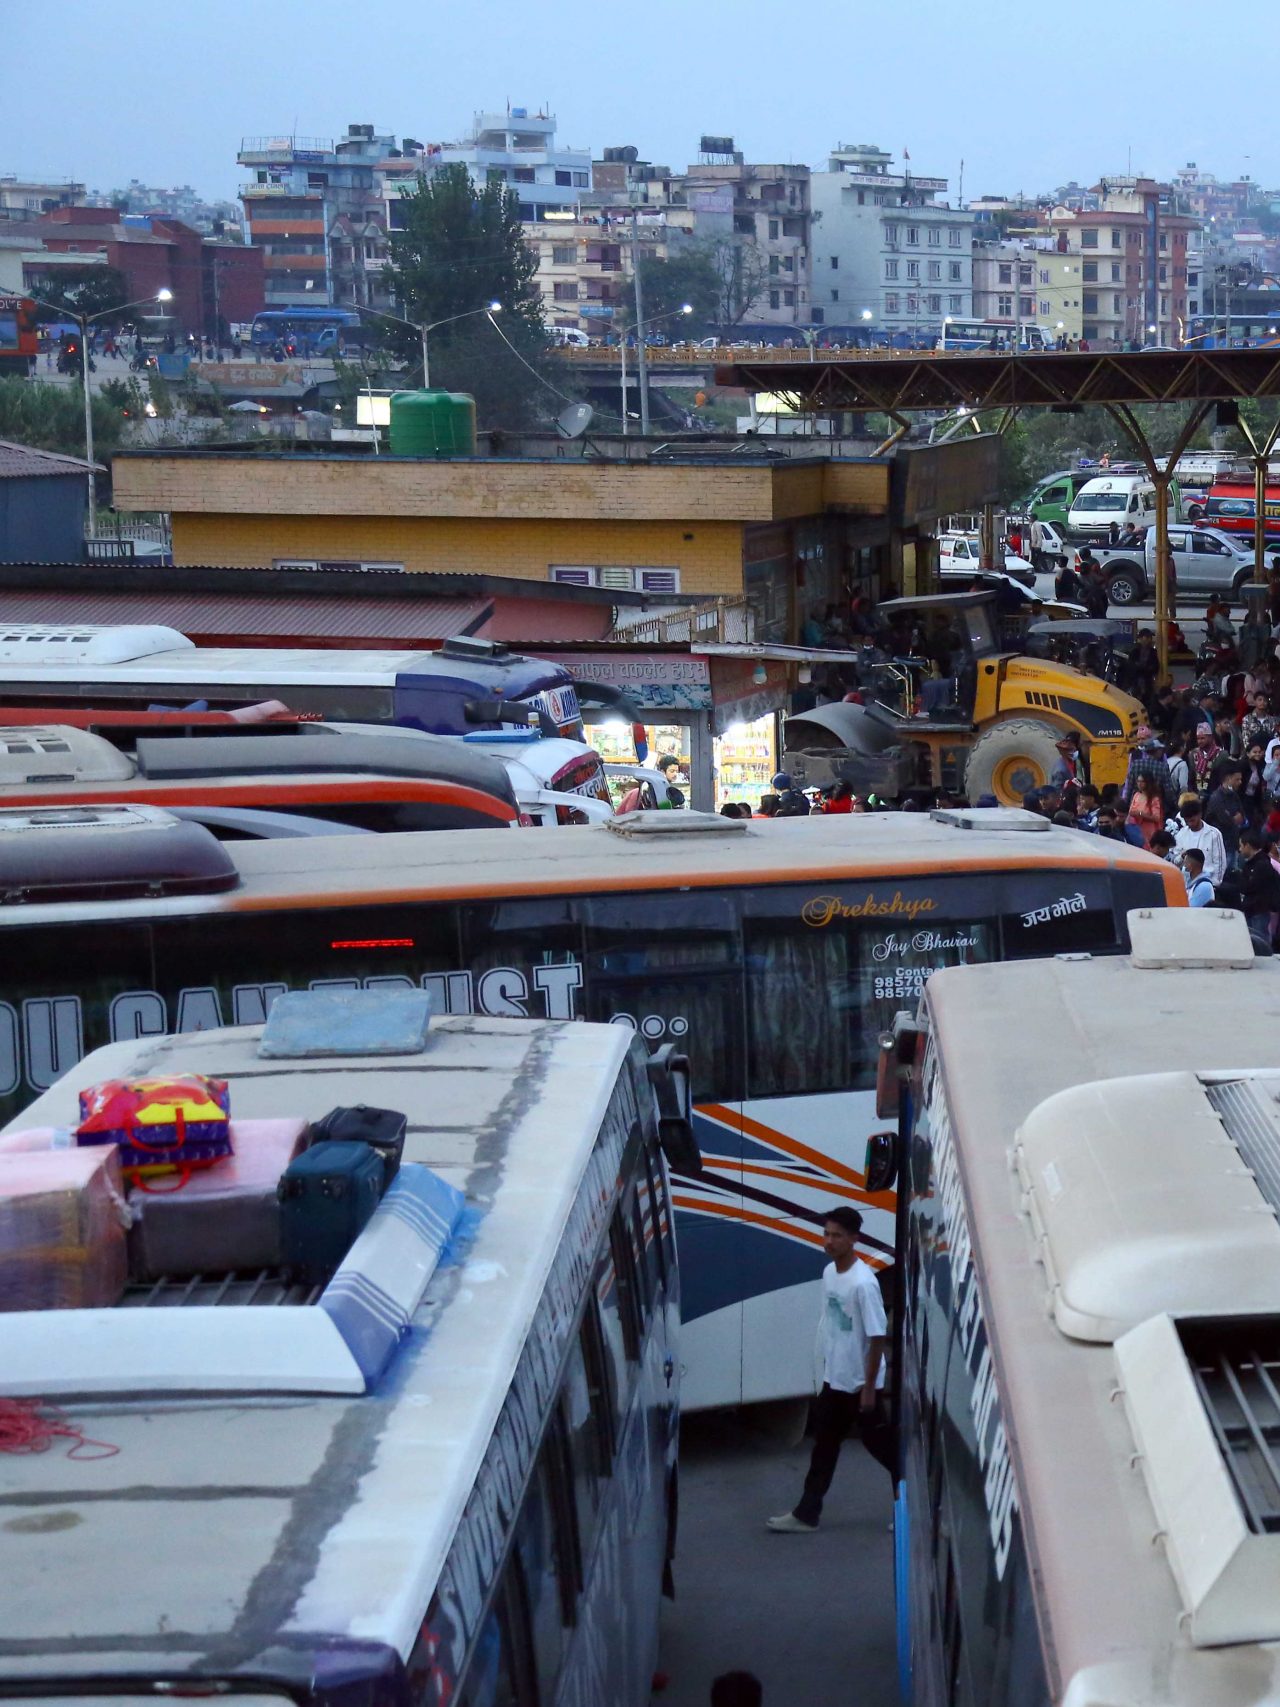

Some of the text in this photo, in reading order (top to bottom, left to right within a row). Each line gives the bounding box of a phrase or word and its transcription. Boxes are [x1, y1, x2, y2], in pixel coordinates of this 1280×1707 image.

[802, 892, 939, 927] Prekshya
[1020, 892, 1088, 928] जय भोले
[872, 933, 911, 962] Jay
[895, 966, 944, 977] Conta
[984, 1419, 1020, 1583] BUS
